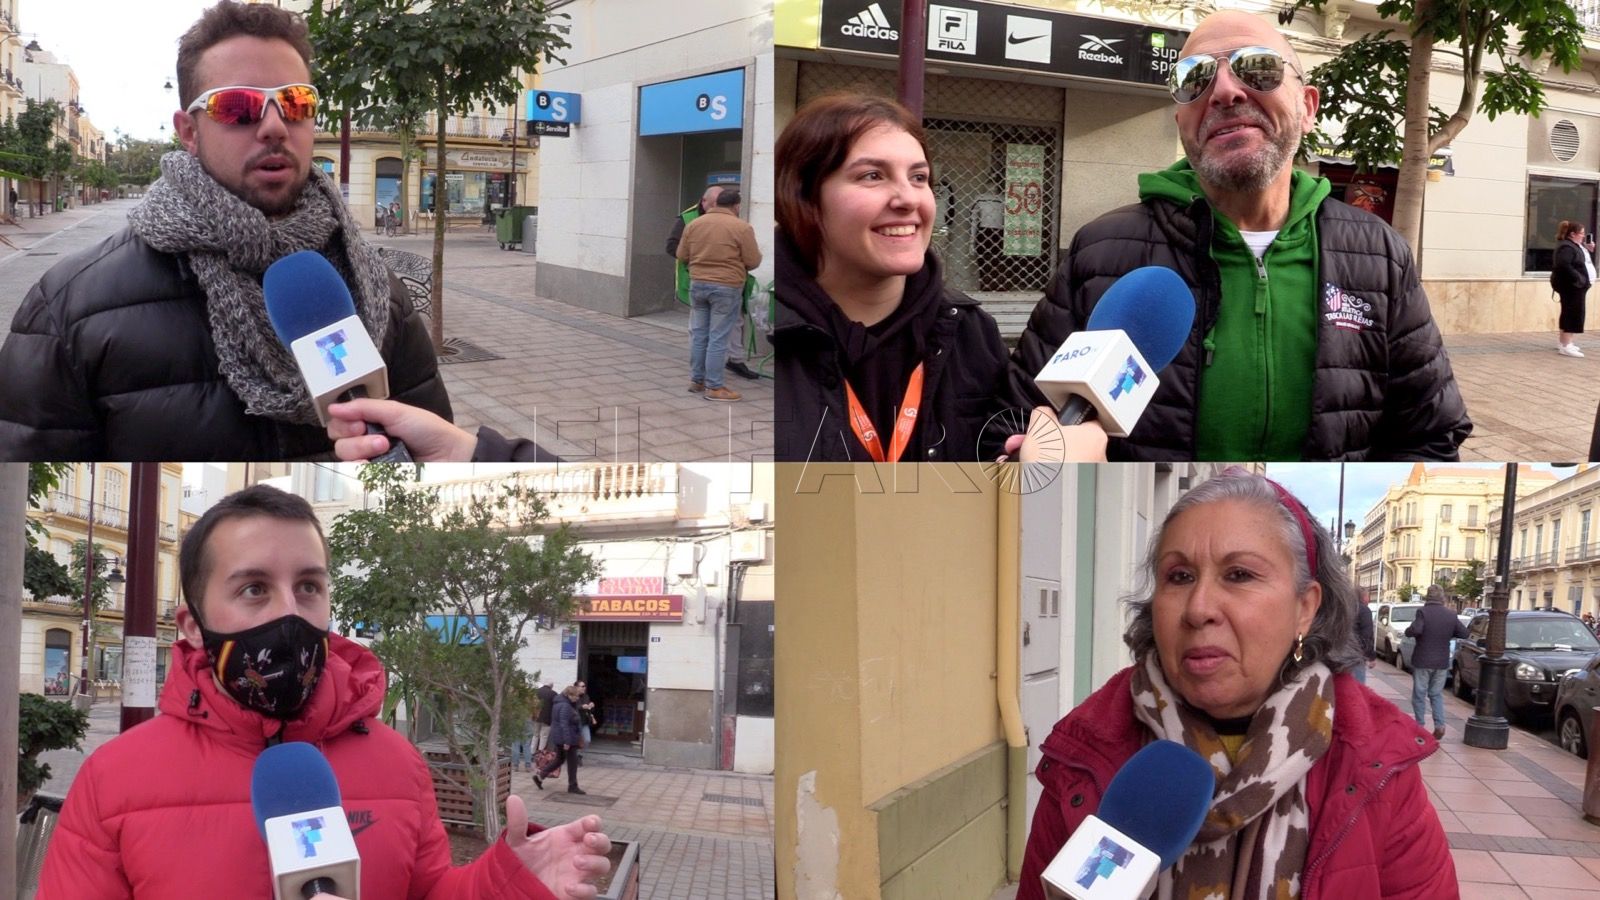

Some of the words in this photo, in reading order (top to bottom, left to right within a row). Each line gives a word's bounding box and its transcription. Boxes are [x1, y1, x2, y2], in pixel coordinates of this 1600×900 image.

[841, 23, 899, 41] adidas
[938, 40, 966, 51] FILA
[1078, 50, 1124, 65] Reebok
[1152, 47, 1182, 61] sup
[1151, 61, 1176, 75] spo
[1052, 346, 1092, 365] FARO
[591, 599, 671, 612] TABACOS
[348, 810, 373, 824] NIKE
